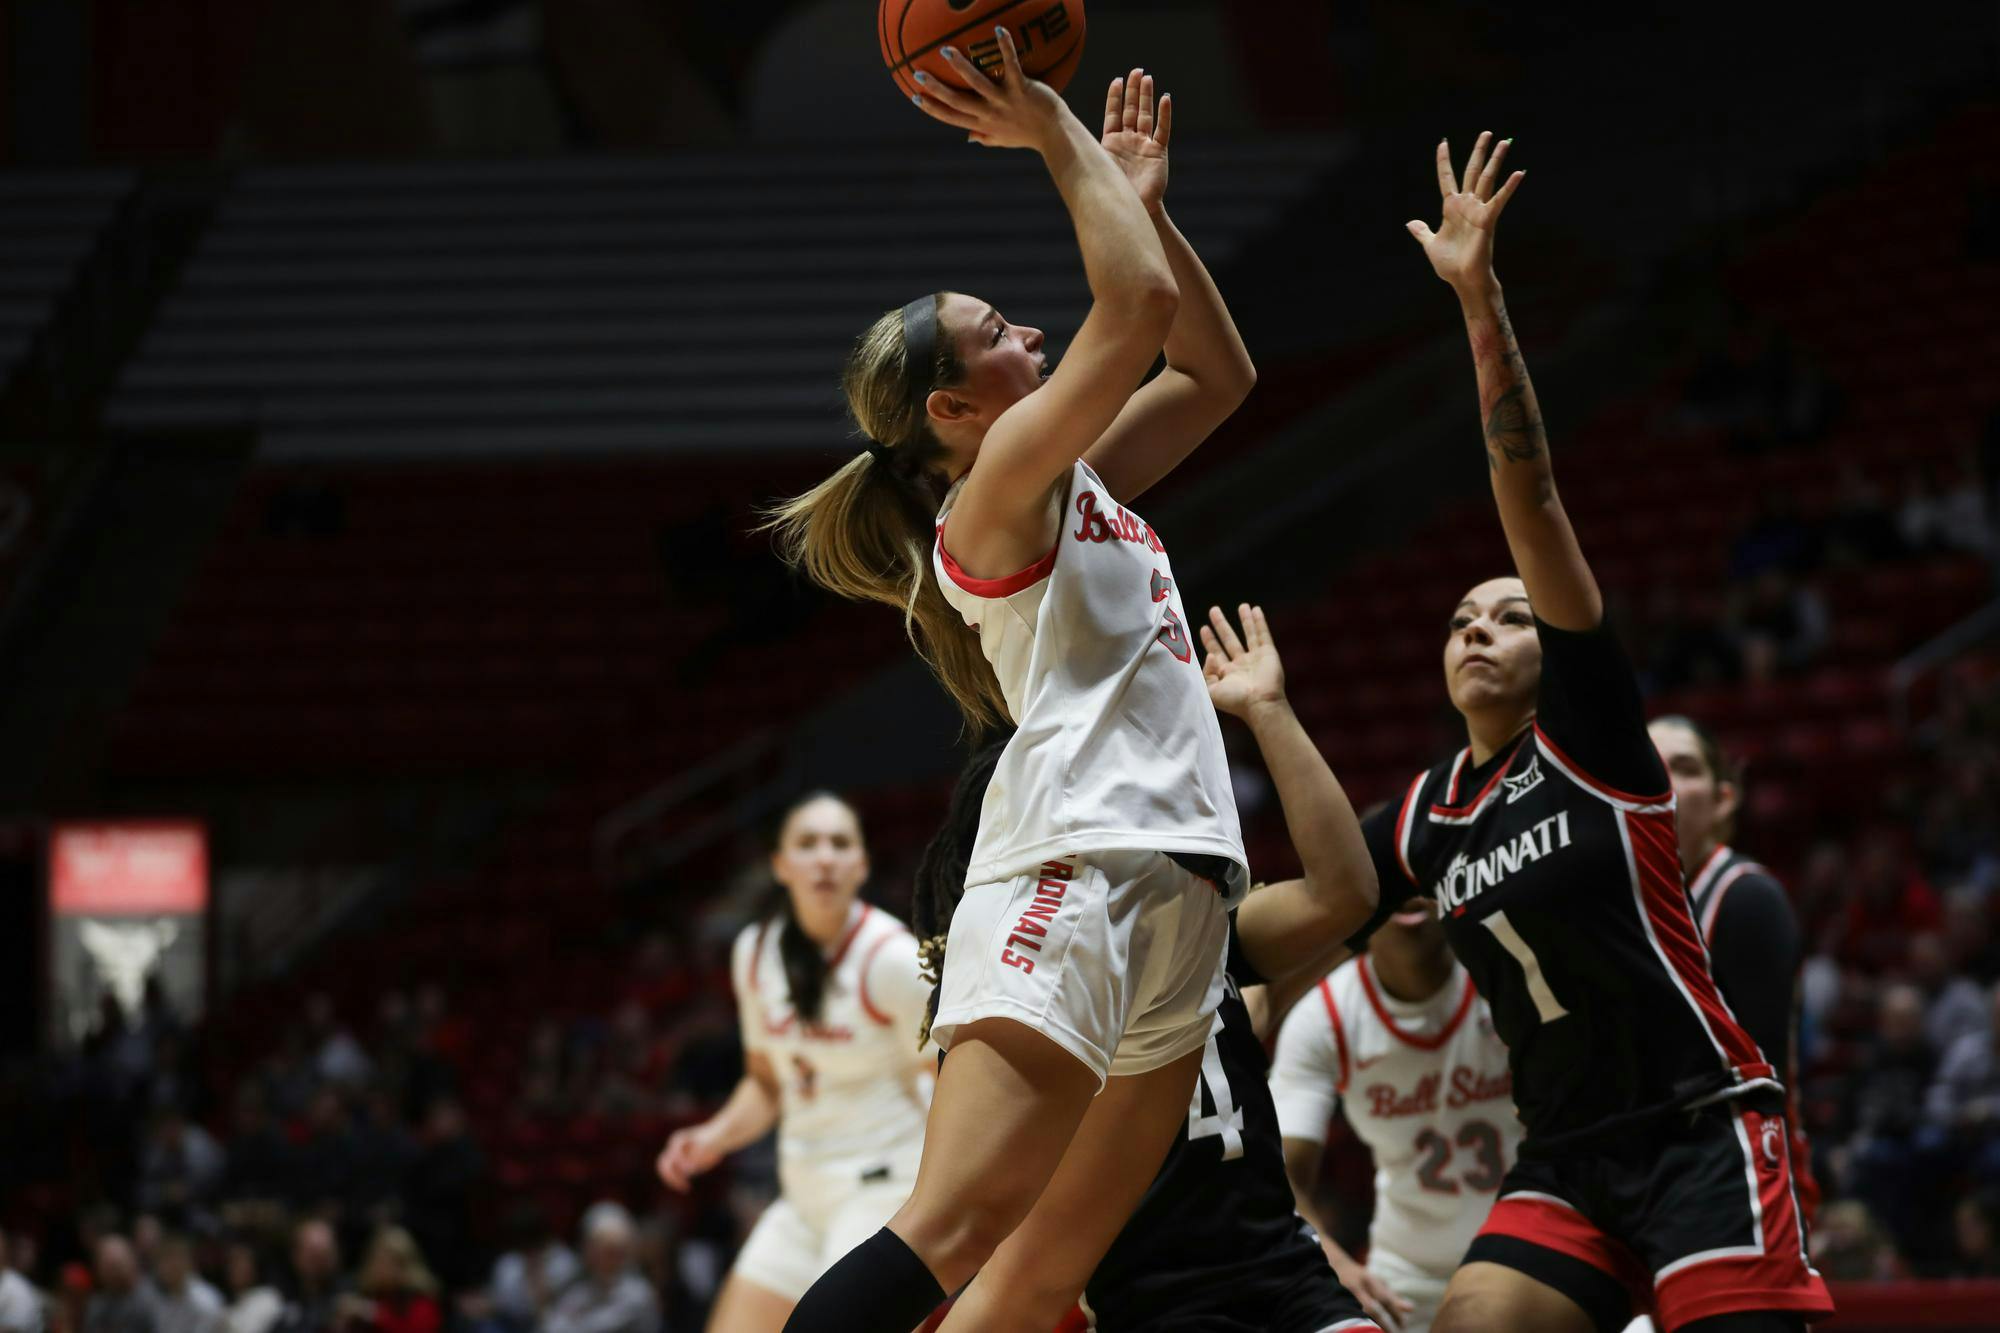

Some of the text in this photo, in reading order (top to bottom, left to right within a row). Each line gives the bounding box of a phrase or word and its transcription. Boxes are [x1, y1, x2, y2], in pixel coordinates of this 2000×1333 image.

[1001, 854, 1076, 975] RDINALS
[1479, 909, 1570, 1024] 1
[1188, 1008, 1245, 1162] 4
[1367, 1072, 1440, 1118] Ball
[1415, 1120, 1505, 1194] 23
